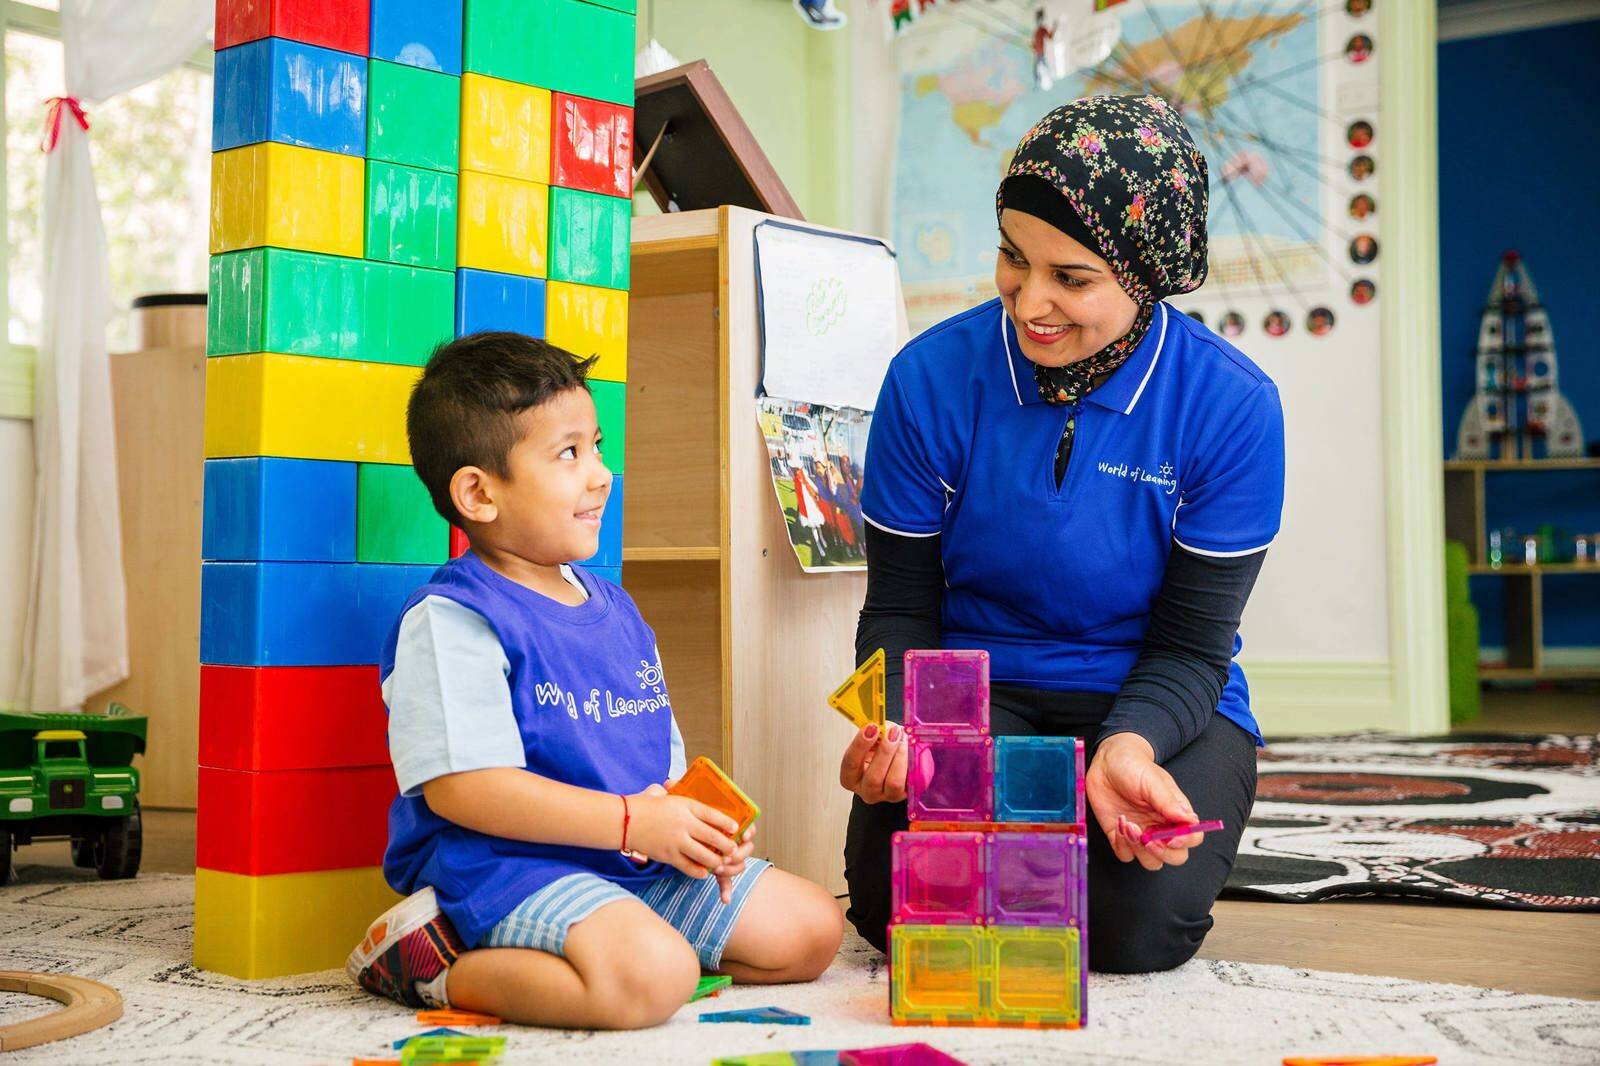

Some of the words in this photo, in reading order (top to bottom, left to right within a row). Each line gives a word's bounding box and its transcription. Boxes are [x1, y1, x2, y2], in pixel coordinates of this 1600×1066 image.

[1098, 462, 1128, 477] World
[1130, 467, 1140, 482] of
[583, 688, 601, 723] of
